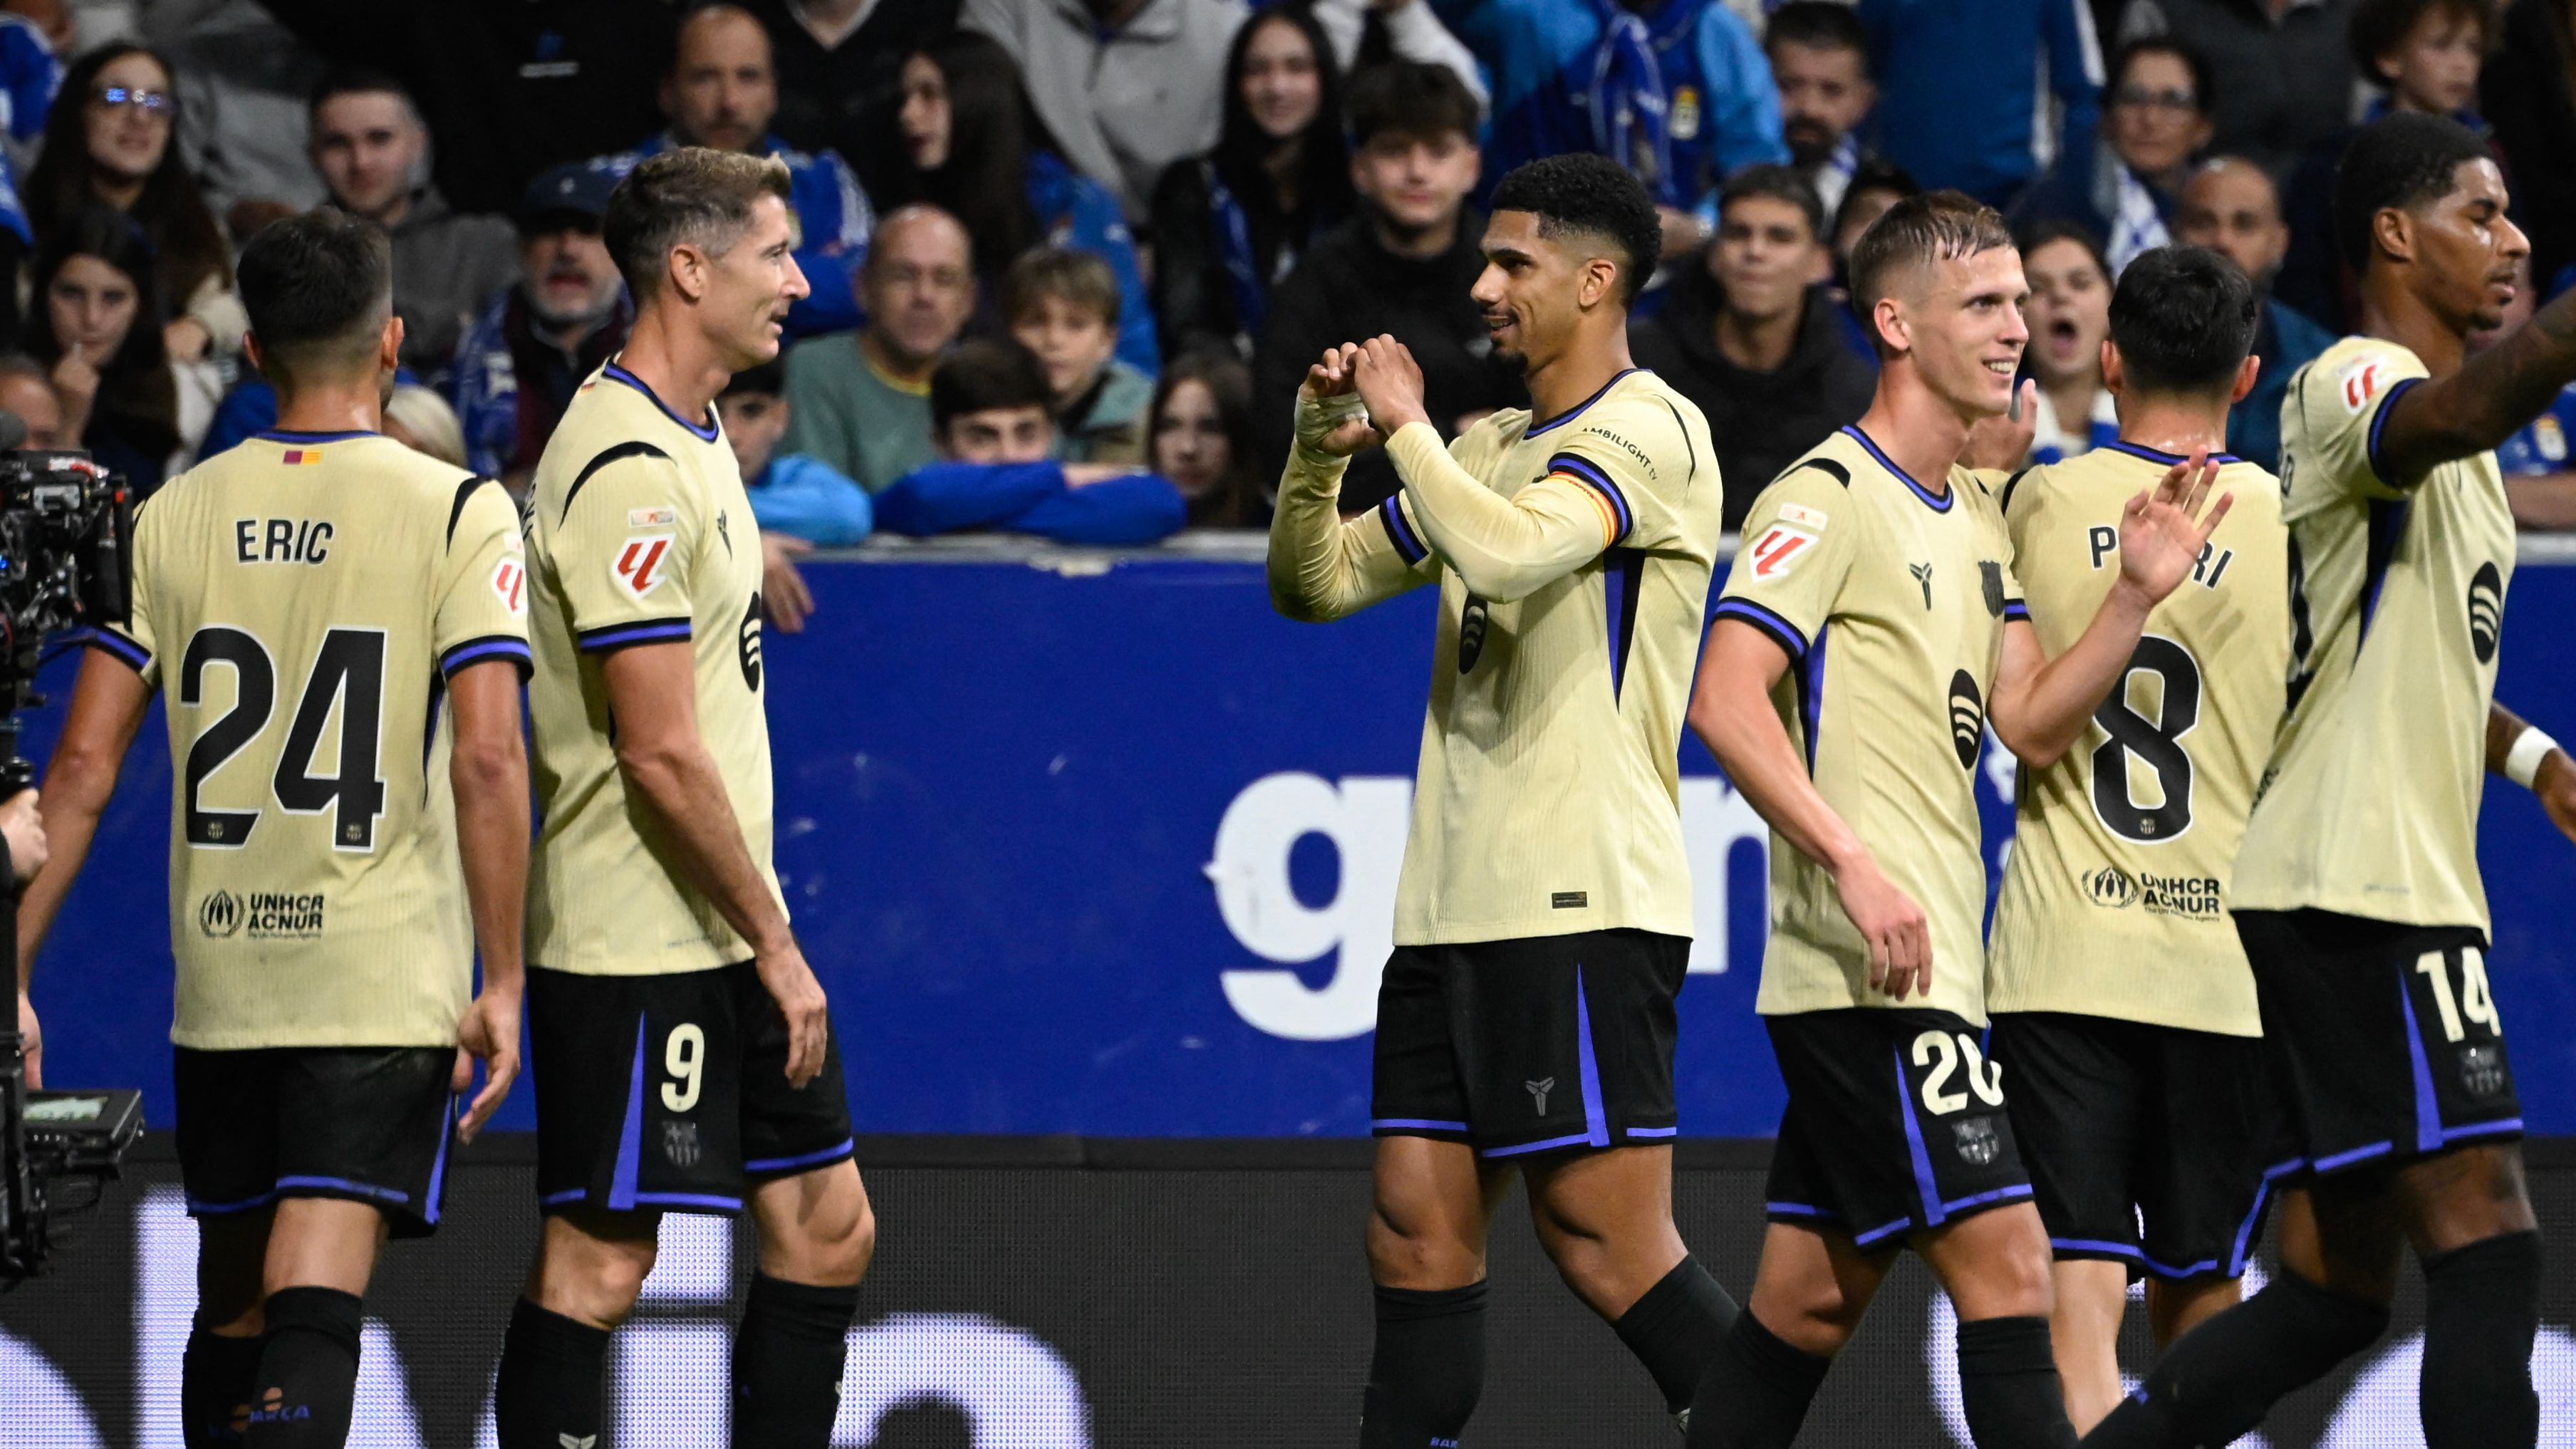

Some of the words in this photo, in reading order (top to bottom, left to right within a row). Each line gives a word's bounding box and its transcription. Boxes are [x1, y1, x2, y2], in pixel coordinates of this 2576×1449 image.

[236, 519, 334, 565] ERIC
[2089, 524, 2234, 590] PRI
[180, 625, 386, 851] 24
[2092, 633, 2202, 845] 8
[250, 893, 324, 912] UNHCR
[2141, 872, 2220, 895] UNHCR
[2143, 889, 2220, 914] ACNUR
[249, 913, 323, 930] ACNUR
[2416, 946, 2502, 1042] 14
[660, 1023, 705, 1112] 9
[1912, 1029, 2004, 1116] 20
